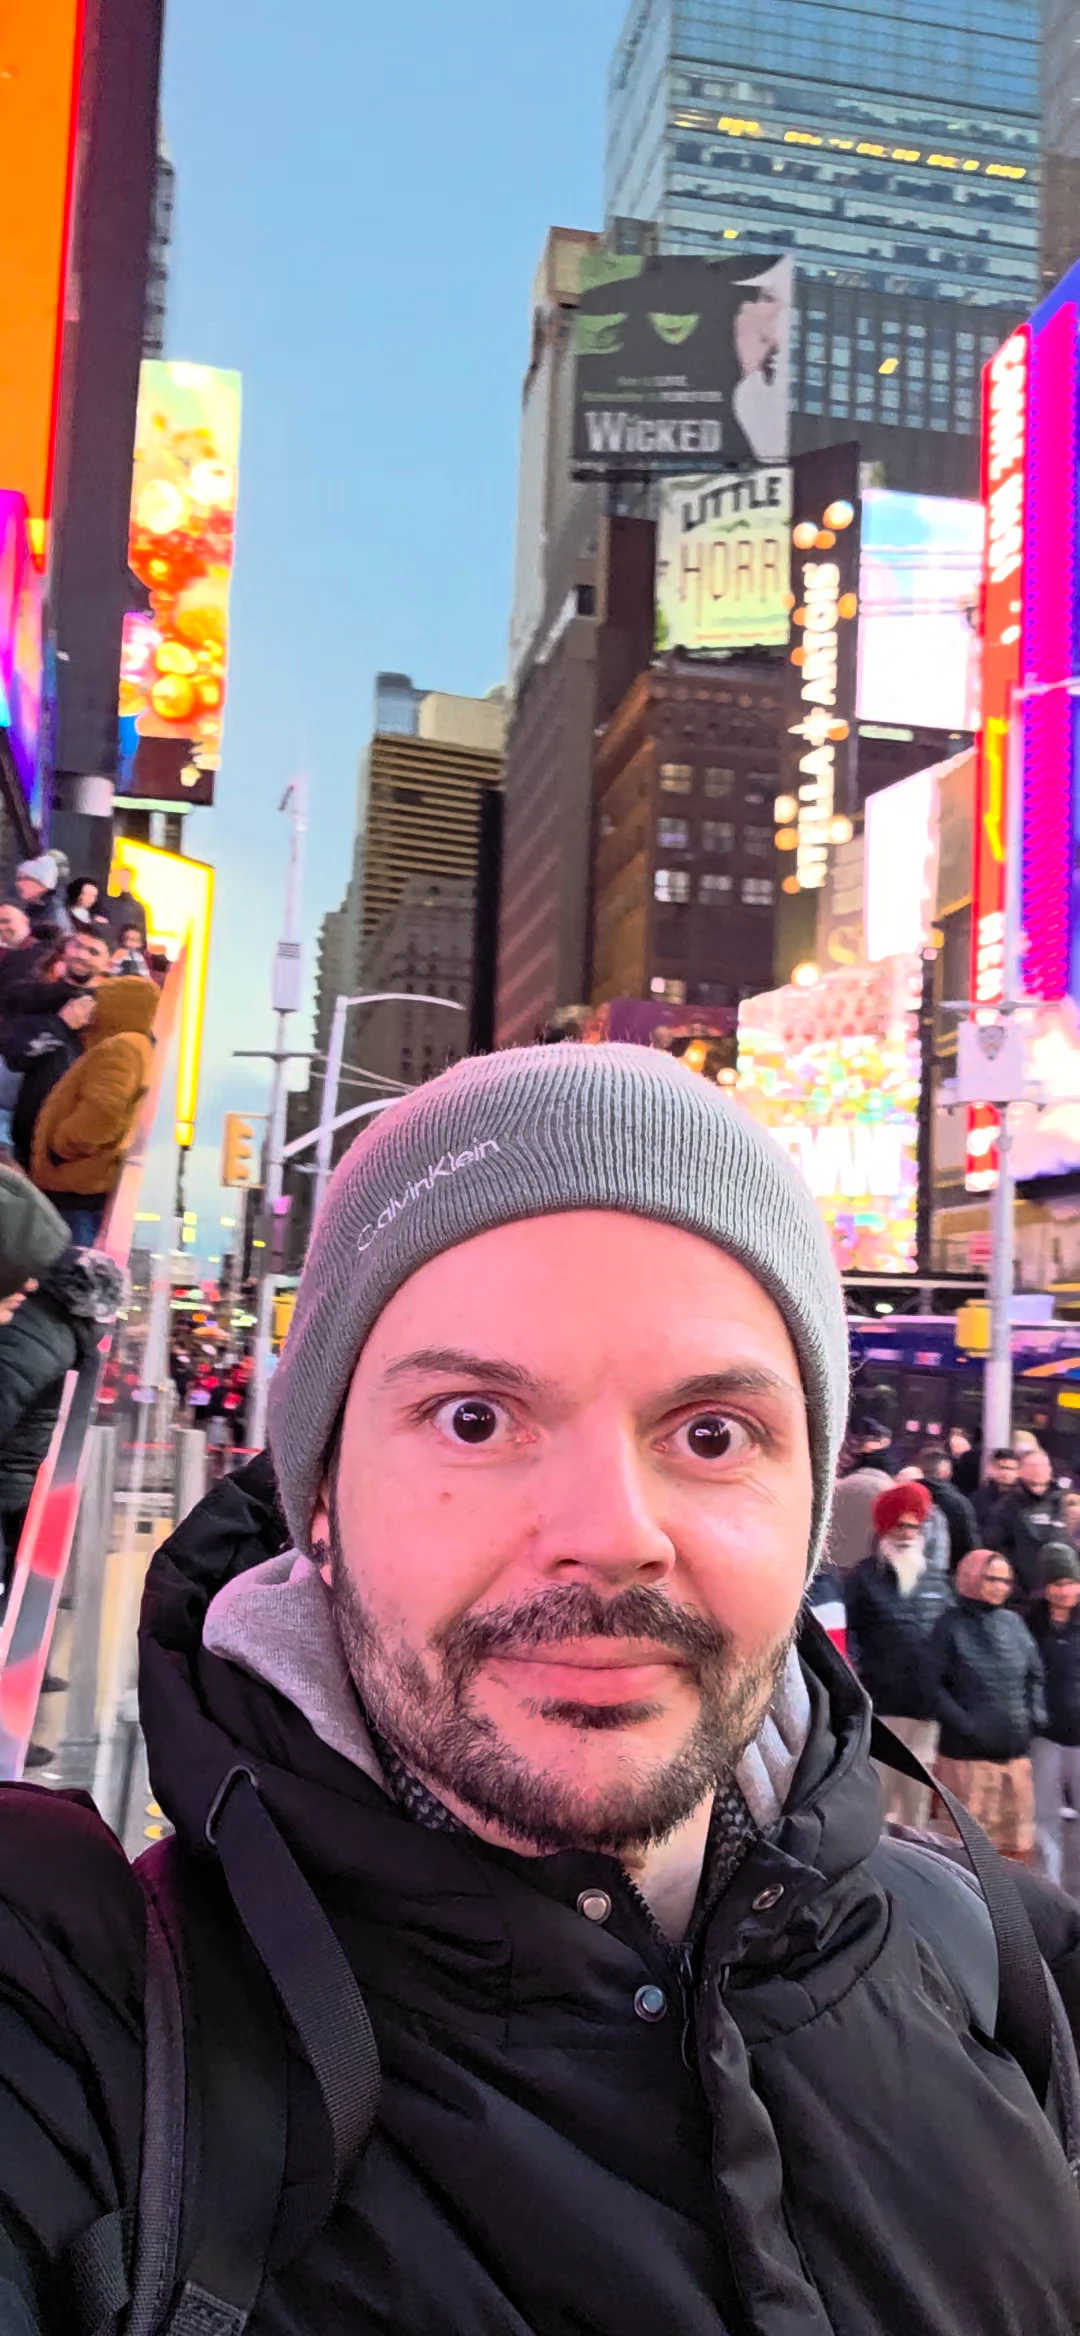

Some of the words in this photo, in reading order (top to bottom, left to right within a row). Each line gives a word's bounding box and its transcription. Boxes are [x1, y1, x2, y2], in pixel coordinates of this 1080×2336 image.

[681, 476, 781, 533] LITTLE
[800, 562, 841, 706] ARTOIS
[797, 745, 836, 889] STELLA
